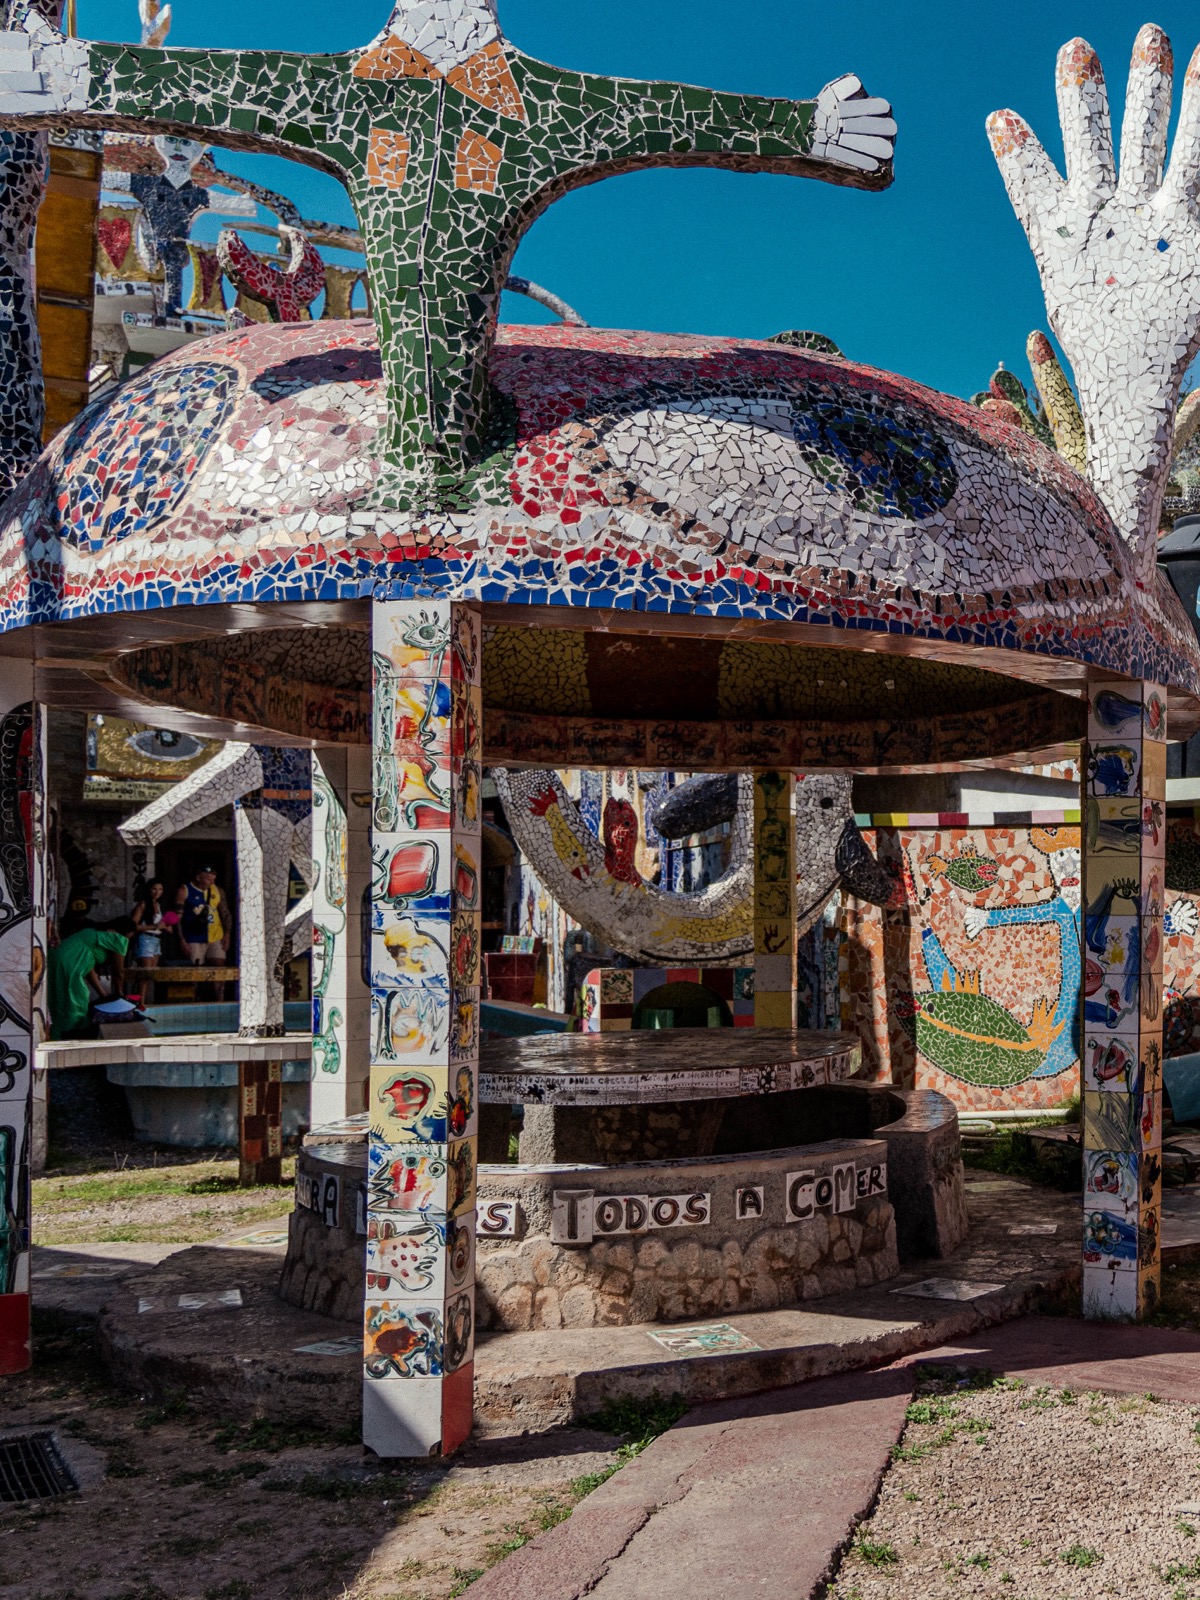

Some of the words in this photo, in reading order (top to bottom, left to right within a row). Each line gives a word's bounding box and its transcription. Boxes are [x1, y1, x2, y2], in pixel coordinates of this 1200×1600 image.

[555, 1190, 707, 1240] TODOS
[739, 1188, 761, 1217] A
[789, 1162, 886, 1219] COMER
